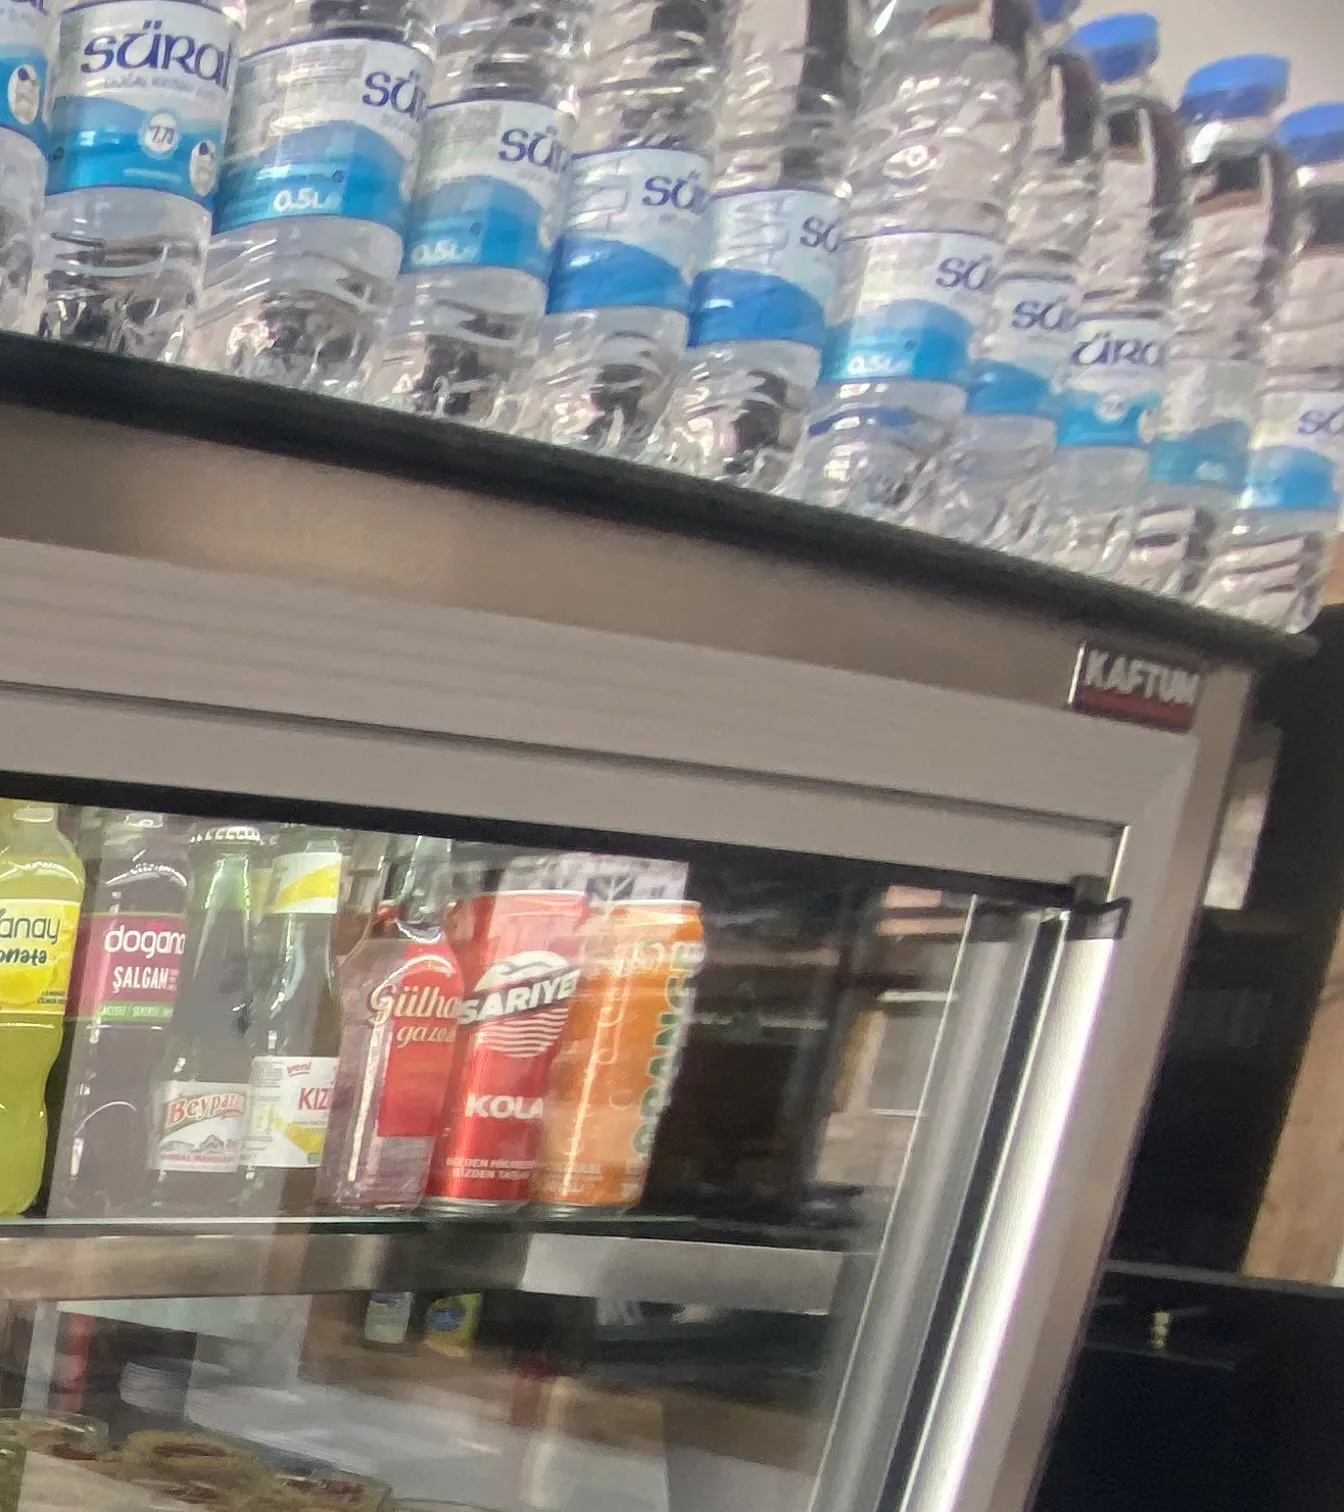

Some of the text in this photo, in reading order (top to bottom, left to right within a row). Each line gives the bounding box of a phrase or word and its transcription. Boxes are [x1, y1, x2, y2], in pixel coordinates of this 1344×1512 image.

[459, 969, 580, 1025] SARIYE
[298, 1087, 331, 1110] KIZ
[465, 1094, 544, 1120] KOLA
